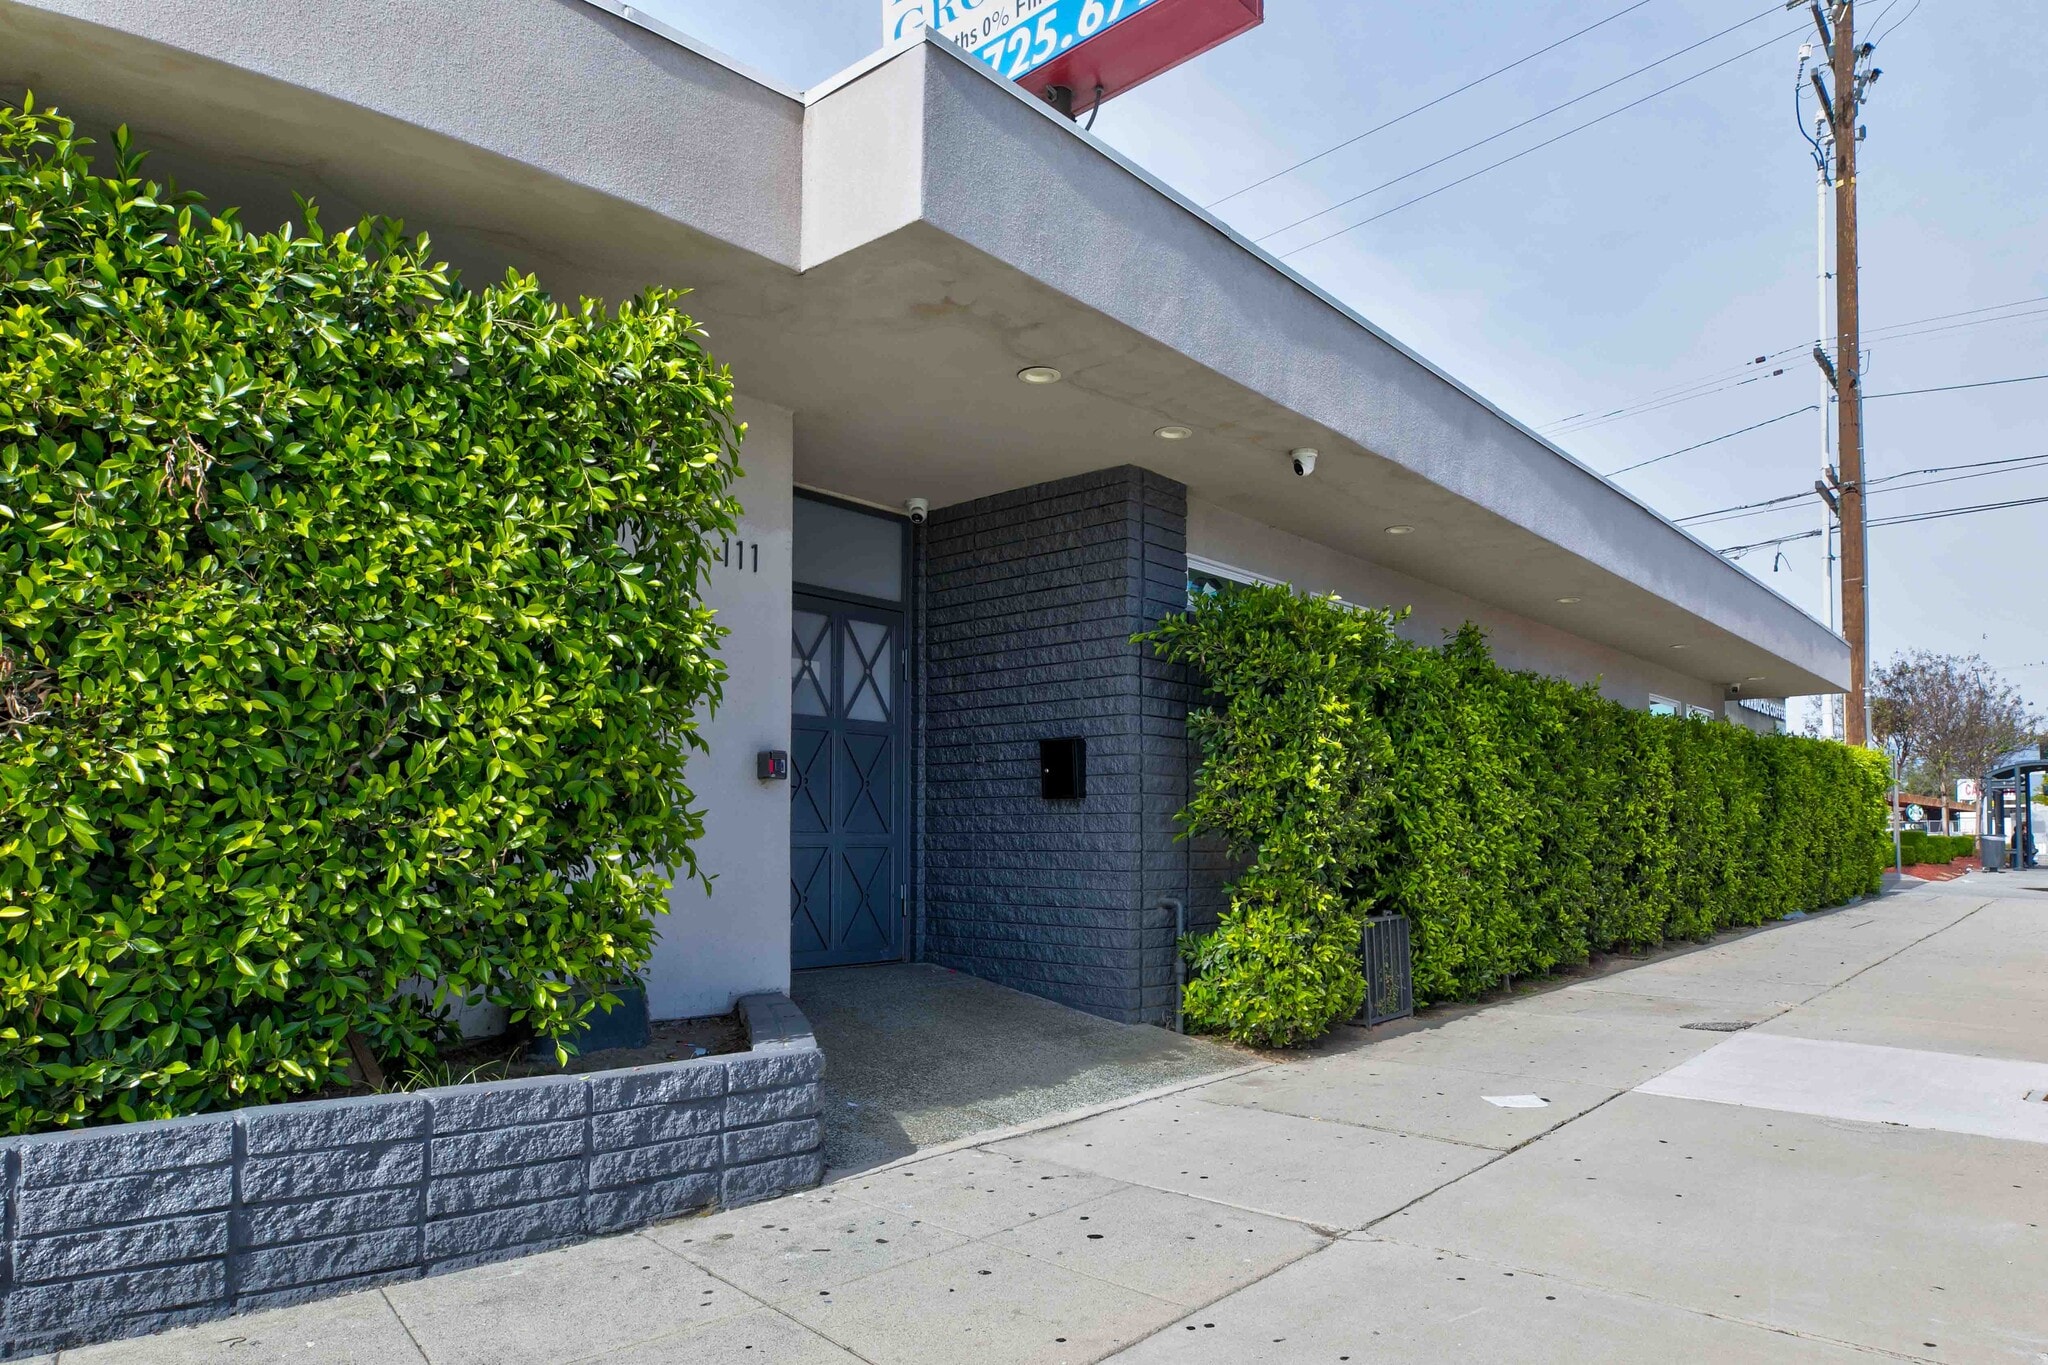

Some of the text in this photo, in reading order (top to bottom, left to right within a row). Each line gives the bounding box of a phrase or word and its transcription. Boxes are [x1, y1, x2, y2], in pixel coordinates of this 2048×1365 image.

[894, 0, 984, 41] GR
[982, 7, 1009, 37] 0%
[722, 537, 759, 573] 111
